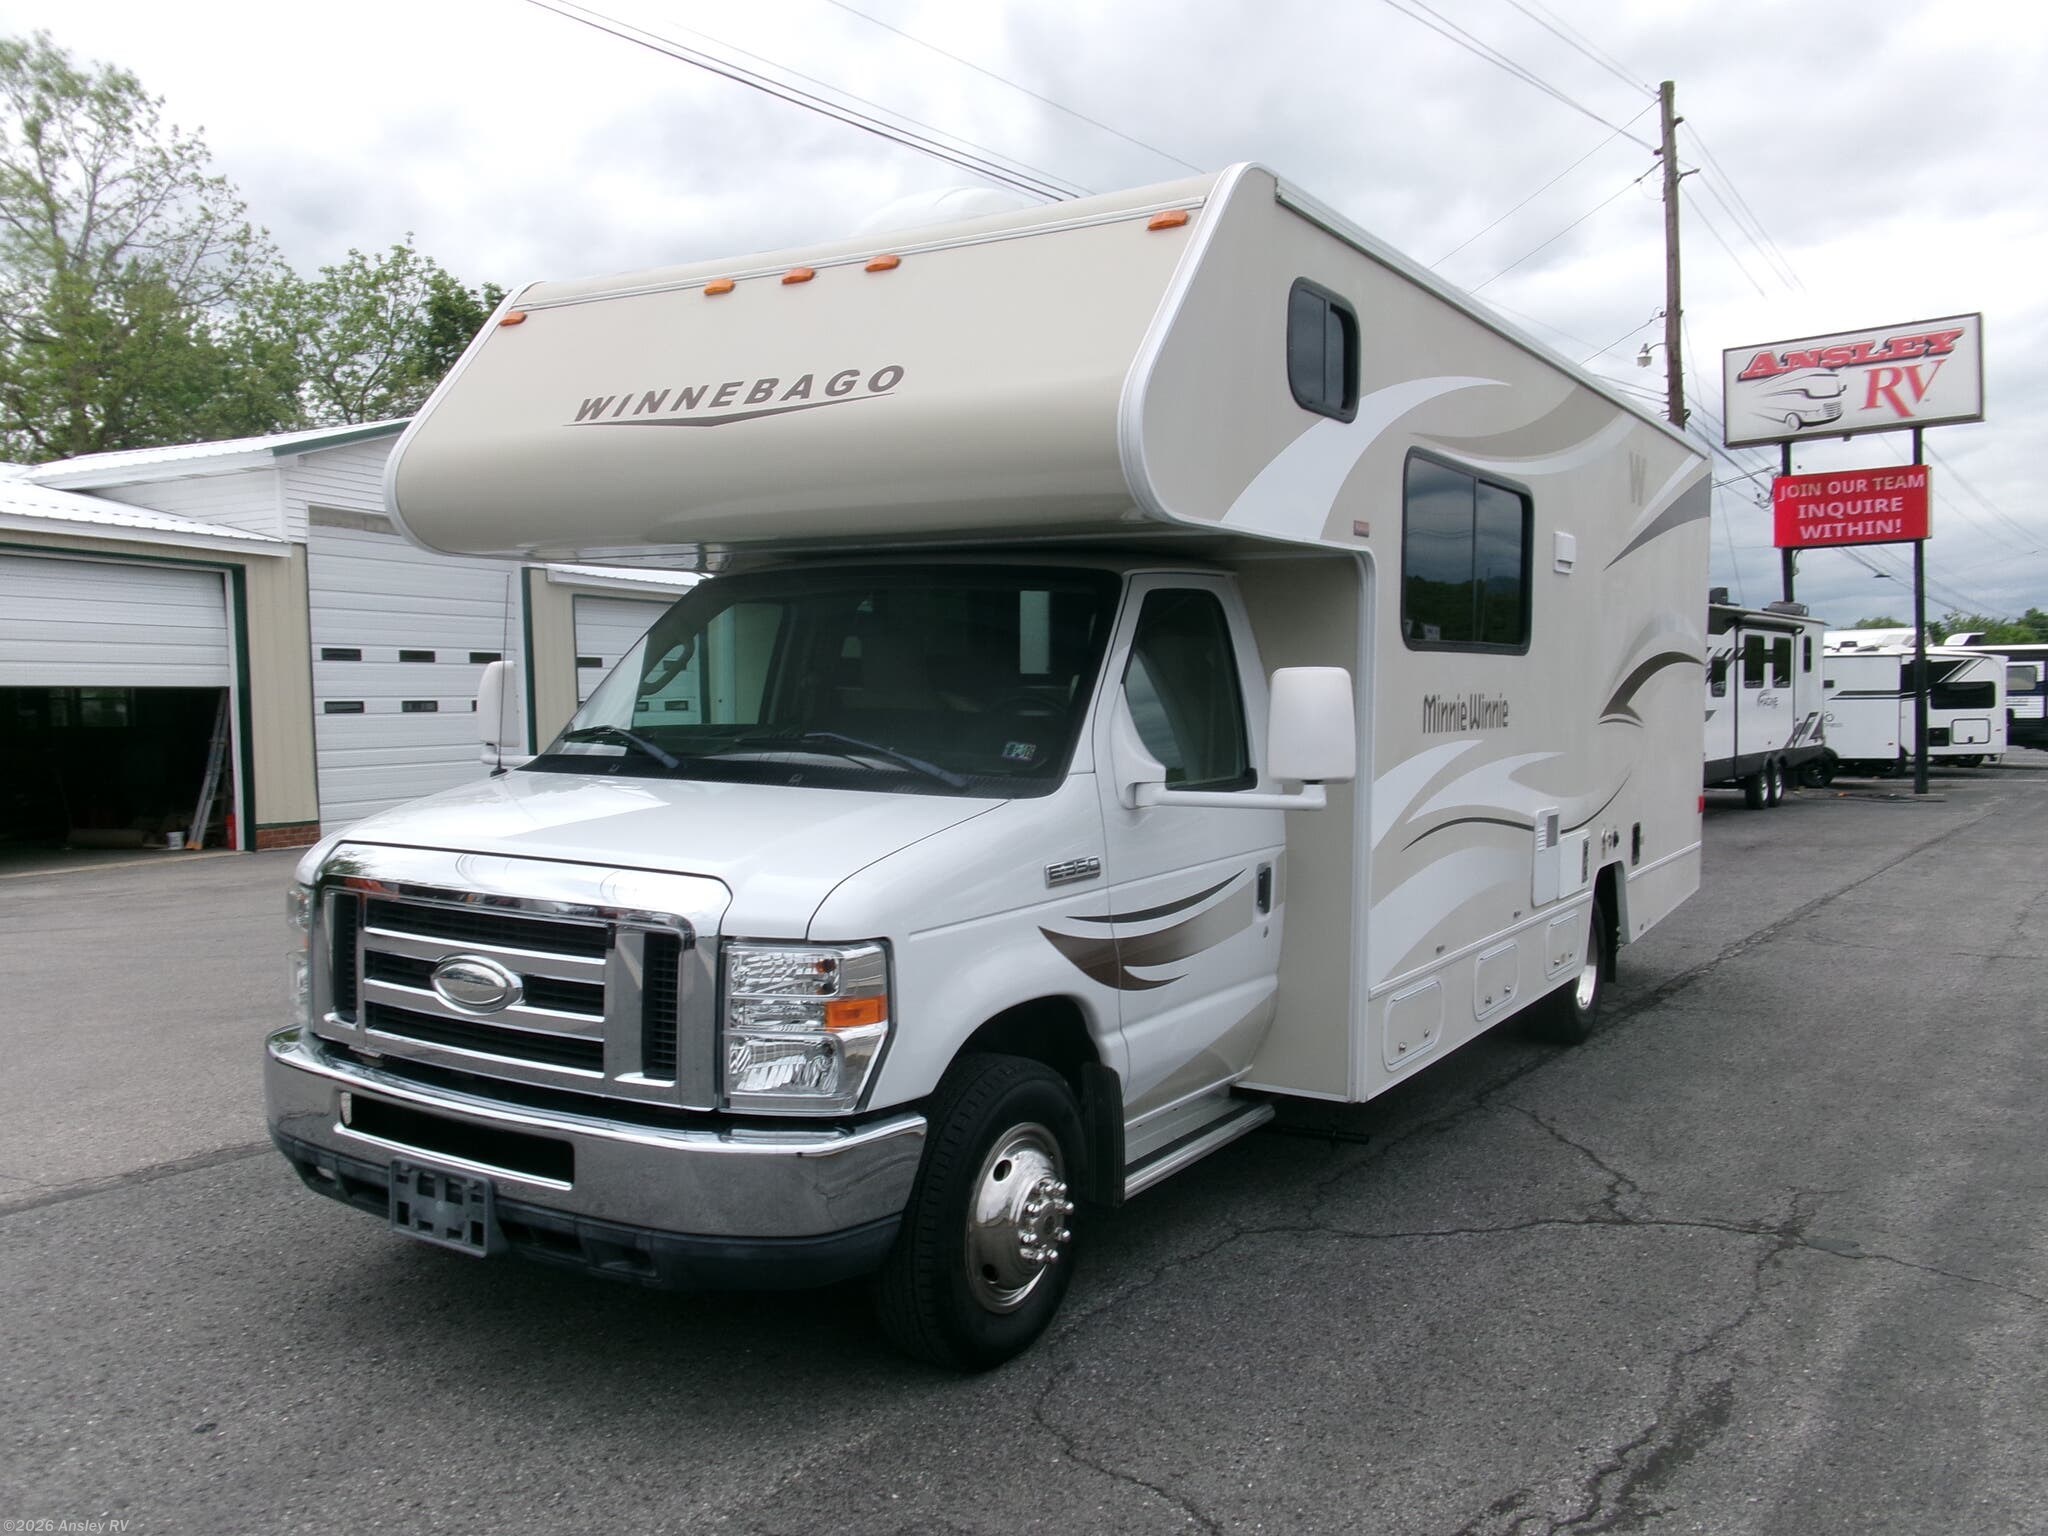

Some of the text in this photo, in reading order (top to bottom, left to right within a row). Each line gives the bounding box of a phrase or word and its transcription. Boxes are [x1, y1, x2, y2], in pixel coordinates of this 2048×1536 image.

[1737, 328, 1965, 381] ANSLEY
[574, 364, 905, 423] WINNEBAGO
[1858, 358, 1946, 419] RV
[1777, 474, 1925, 502] JOIN OUR TEAM
[1797, 496, 1904, 519] INQUIRE
[1800, 519, 1903, 540] WITHIN!
[1423, 693, 1509, 734] Minnie Winnie
